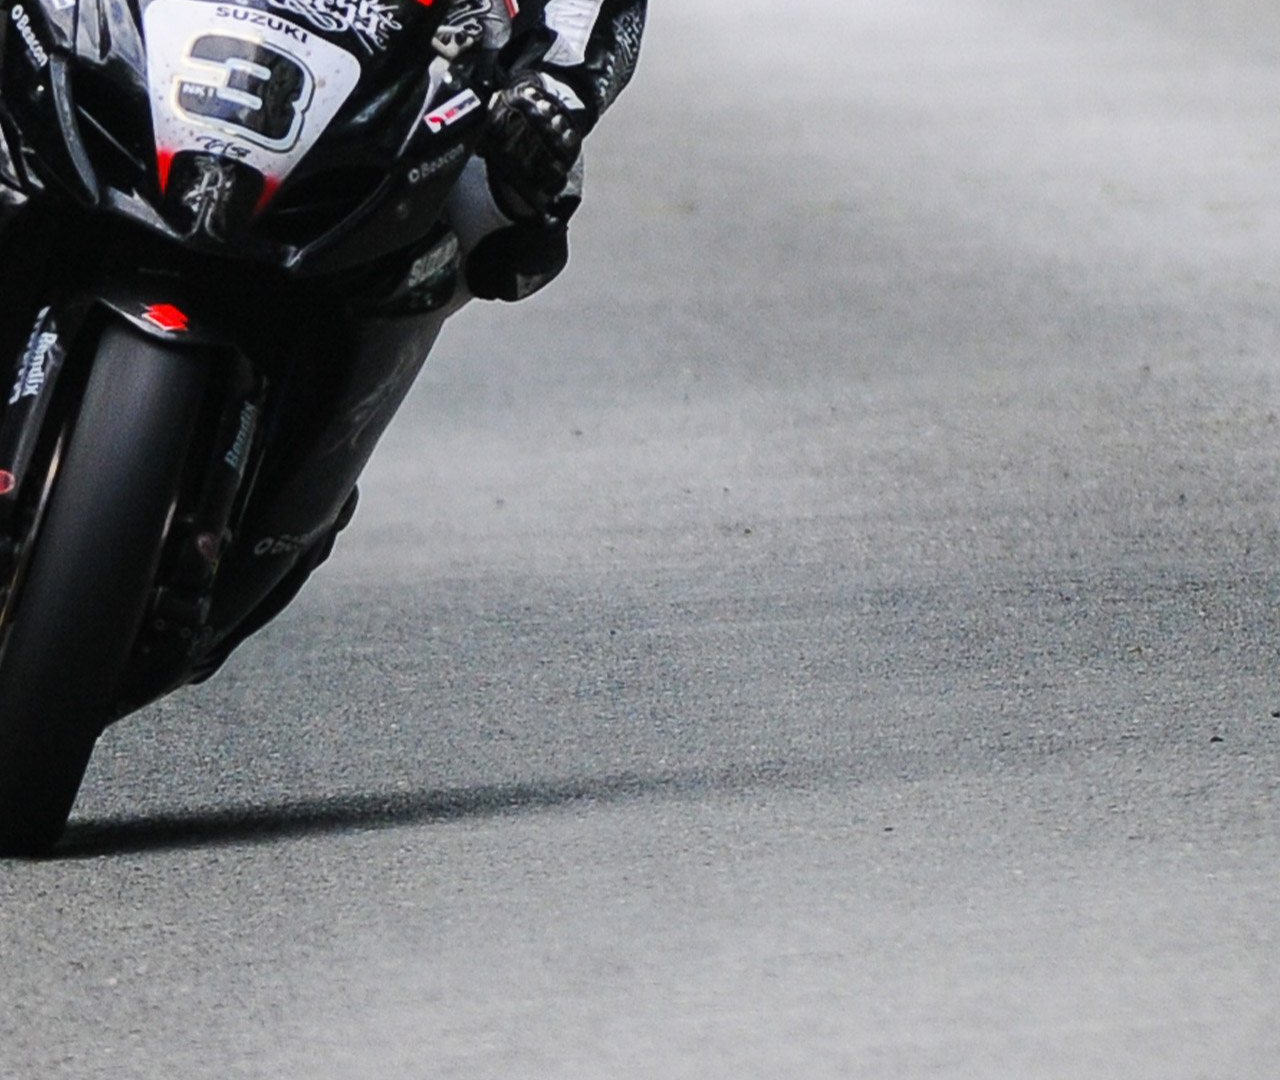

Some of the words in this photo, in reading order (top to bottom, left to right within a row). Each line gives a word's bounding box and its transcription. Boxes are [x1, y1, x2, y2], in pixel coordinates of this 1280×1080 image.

[16, 13, 49, 67] Beacon
[216, 6, 308, 44] SUZUKI
[171, 30, 316, 154] 3
[22, 331, 58, 397] Bendix
